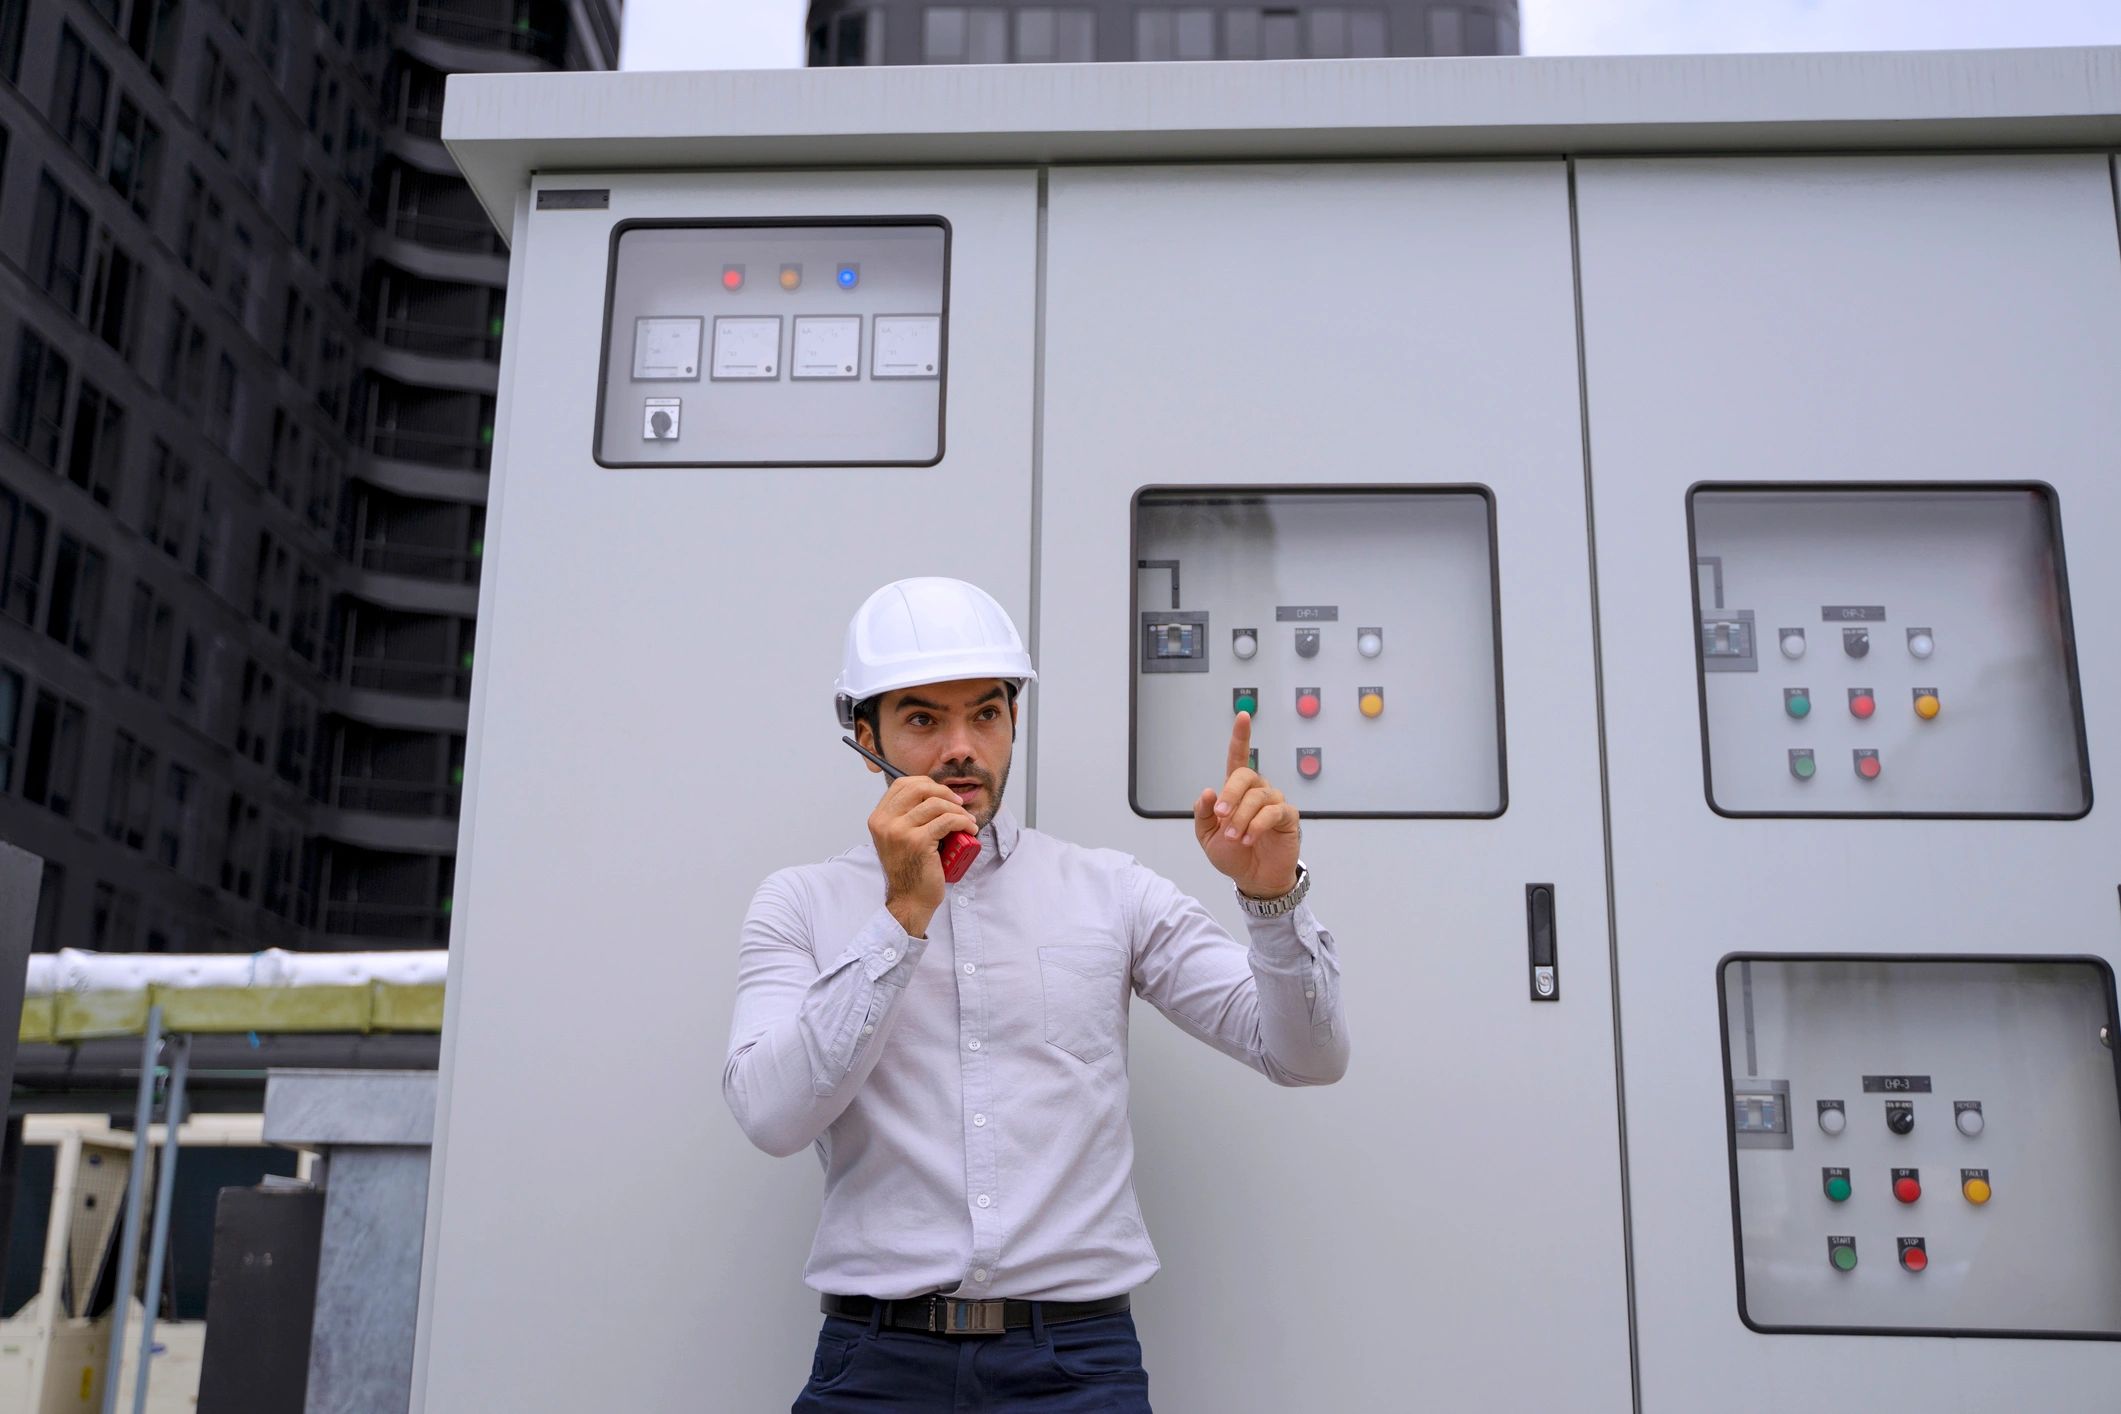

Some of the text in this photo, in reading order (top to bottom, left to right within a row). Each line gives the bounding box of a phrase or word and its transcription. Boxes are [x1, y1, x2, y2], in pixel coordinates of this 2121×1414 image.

[1297, 608, 1318, 618] CHP-1
[1842, 608, 1865, 618] CHP-2
[1885, 1078, 1909, 1089] CHP-3
[1830, 1168, 1842, 1176] RUN
